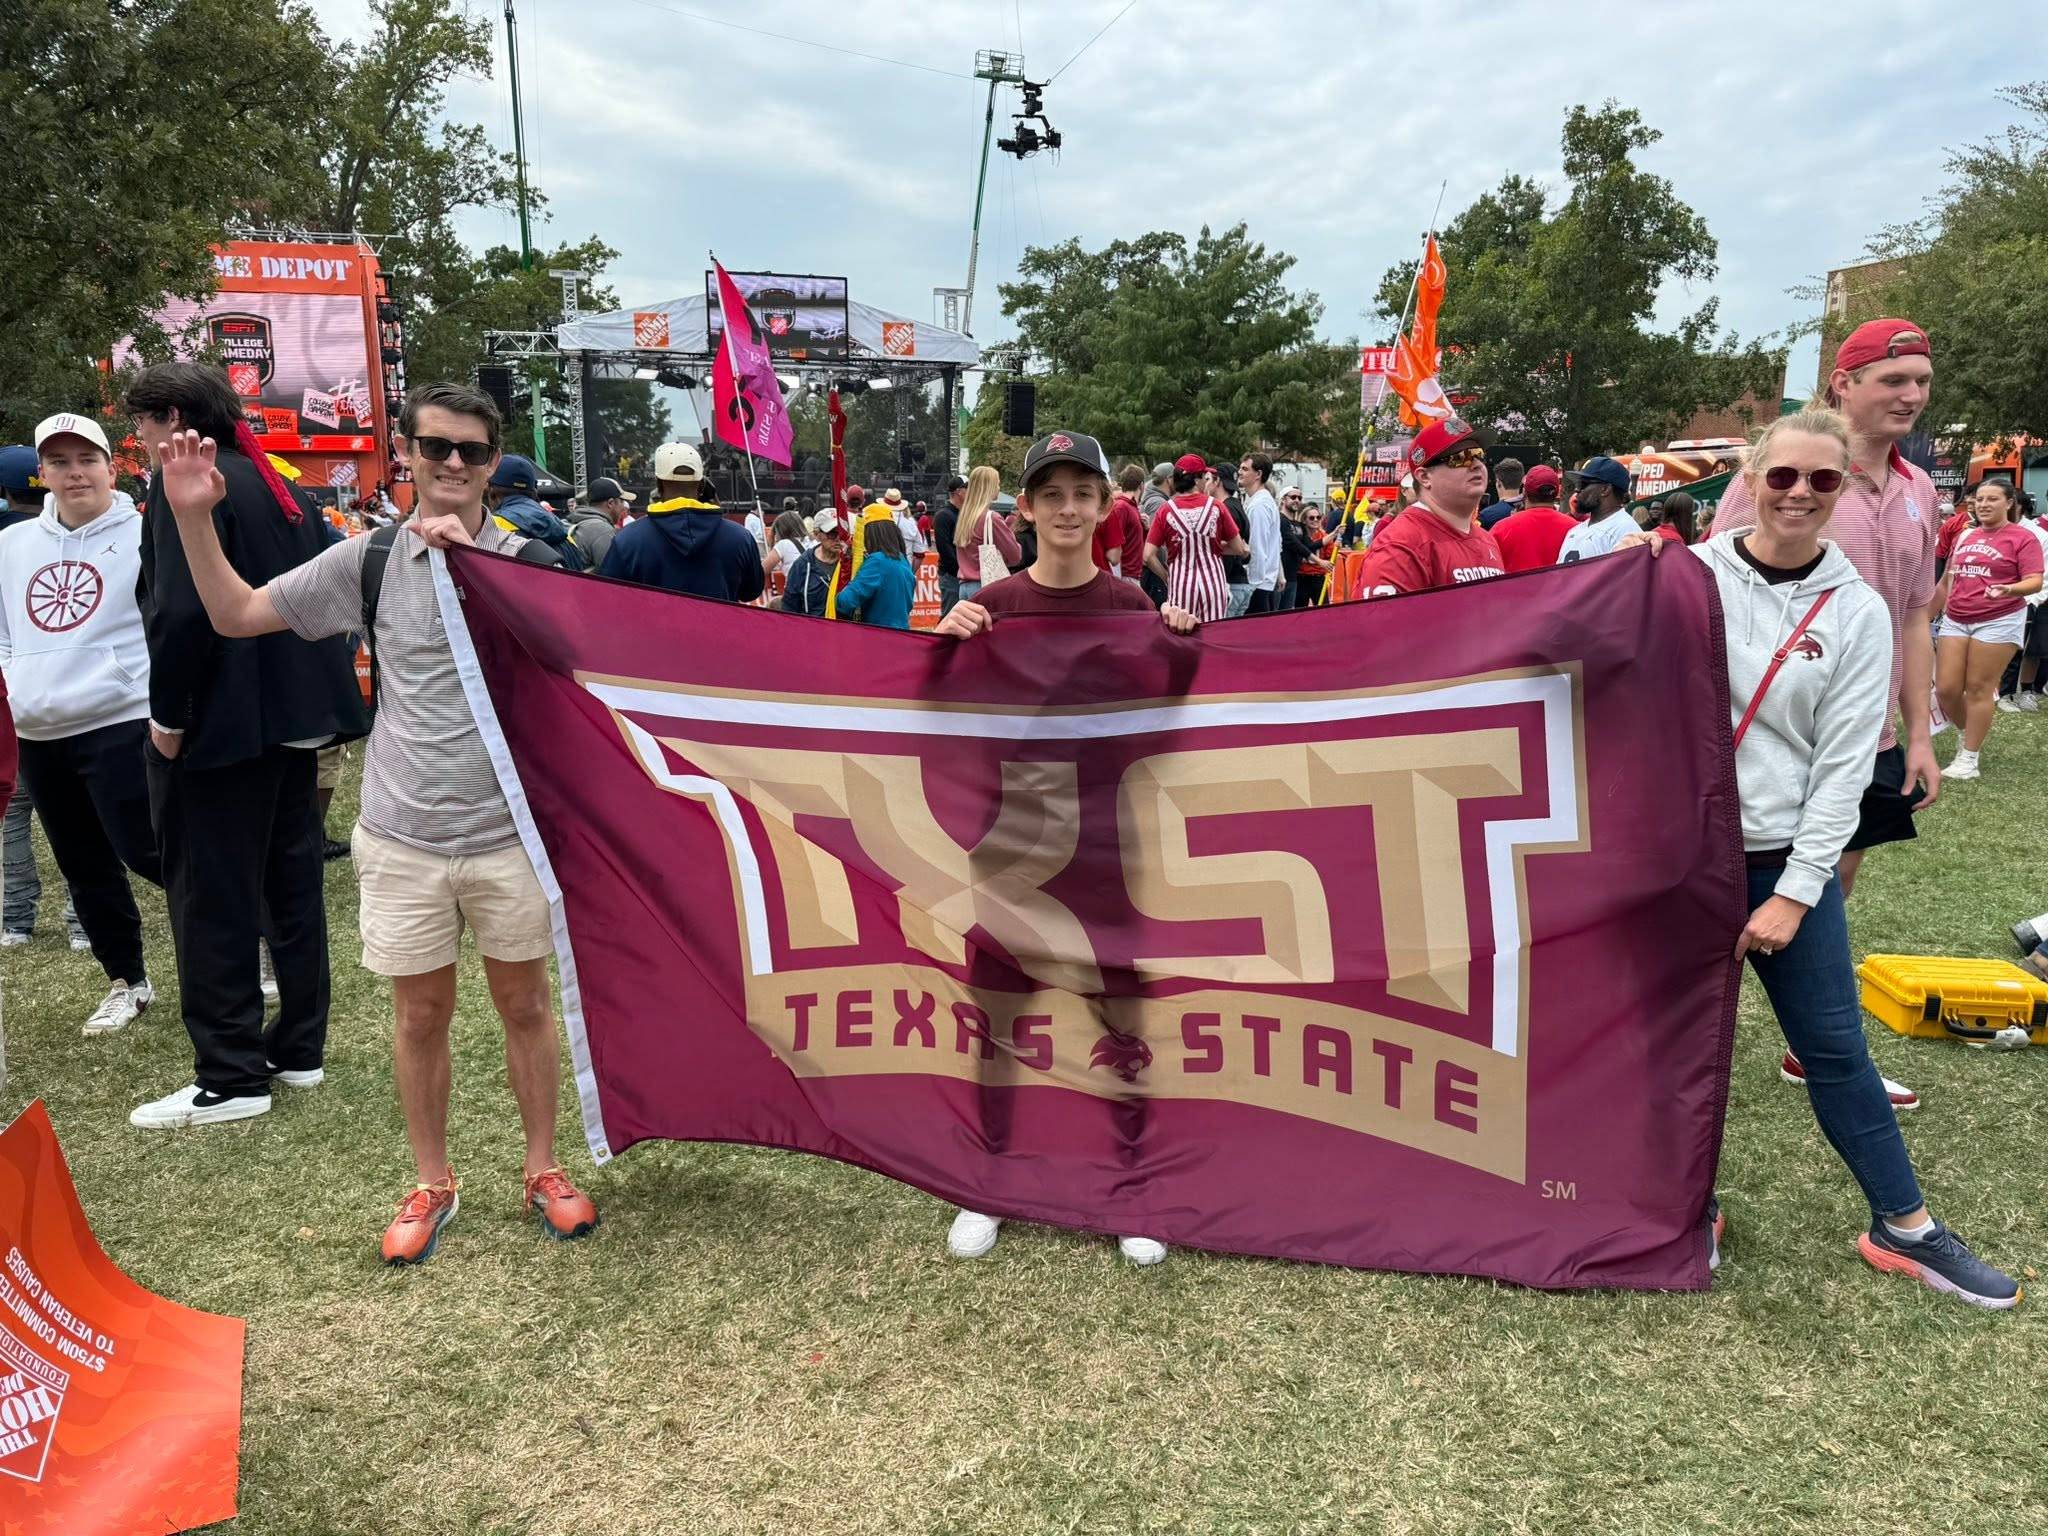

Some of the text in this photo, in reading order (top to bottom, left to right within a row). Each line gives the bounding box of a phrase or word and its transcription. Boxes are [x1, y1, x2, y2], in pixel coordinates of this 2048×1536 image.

[213, 255, 349, 281] ME DEPOT
[223, 322, 256, 332] ESPN
[635, 312, 667, 346] HOME
[222, 338, 265, 348] OLLEGE
[883, 324, 913, 355] HOME
[221, 348, 272, 359] AMEDAY
[1364, 352, 1397, 369] TH
[1635, 480, 1681, 497] AMEDAY
[1932, 477, 1966, 487] AMEDAY
[783, 987, 1479, 1136] TEXAS STATE
[1541, 1179, 1577, 1201] SM
[5, 1246, 115, 1355] TO VETERAN CAUSES
[56, 1335, 106, 1373] $750M
